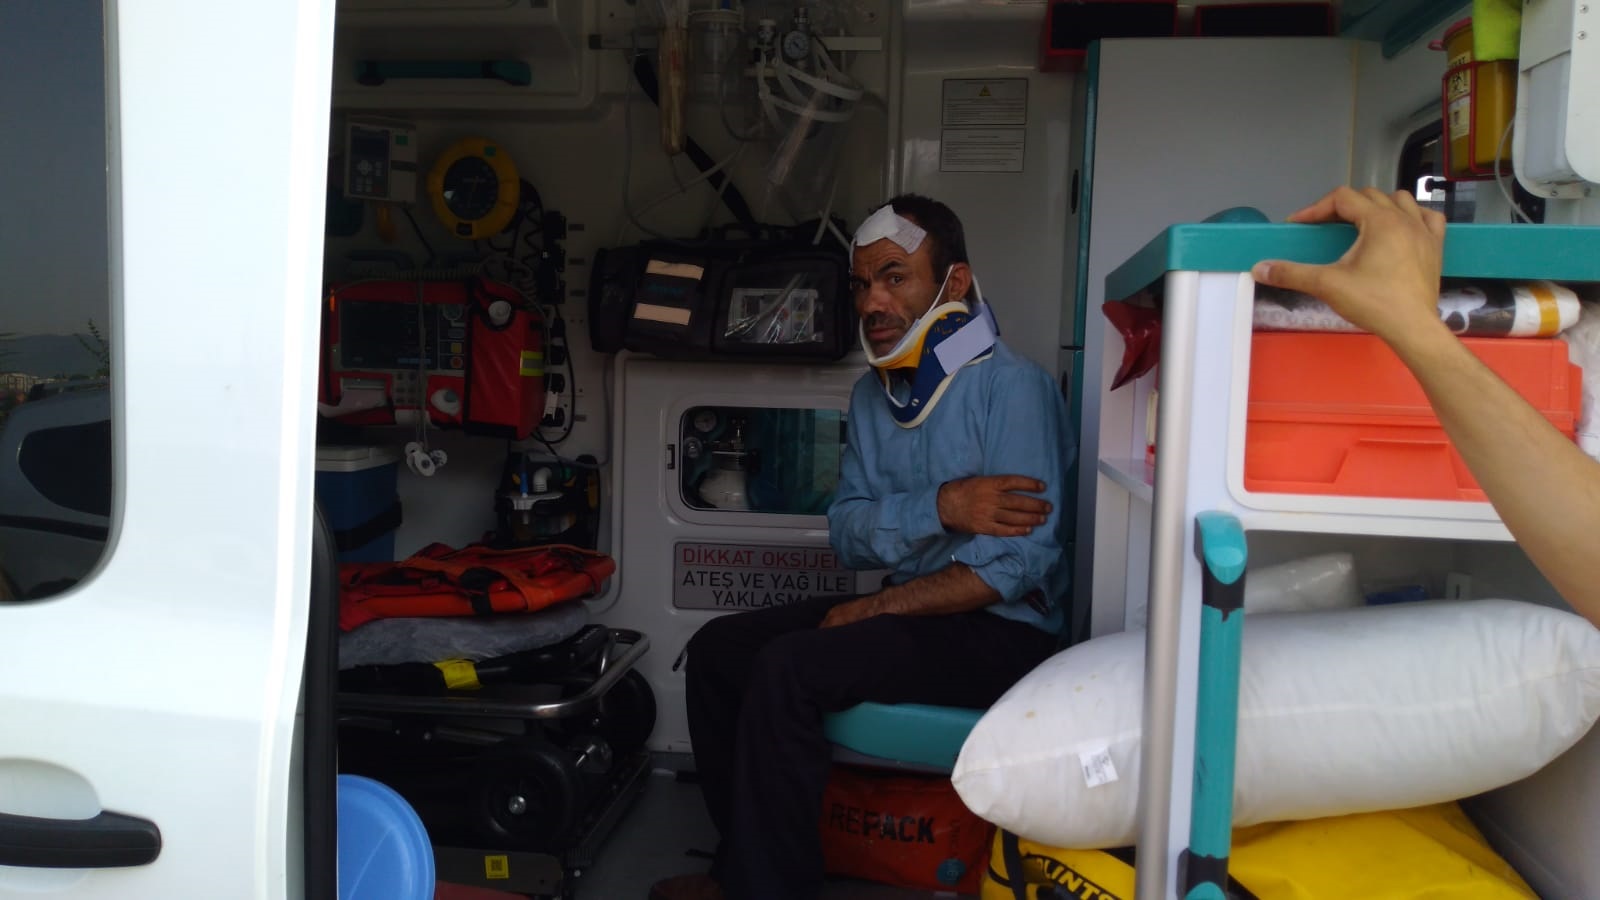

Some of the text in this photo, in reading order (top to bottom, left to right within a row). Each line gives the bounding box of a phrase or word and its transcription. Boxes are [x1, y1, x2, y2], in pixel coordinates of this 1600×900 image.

[683, 546, 755, 565] DİKKAT
[682, 570, 849, 592] ATEŞ VE YAĞ İLE
[830, 803, 935, 844] REPACK
